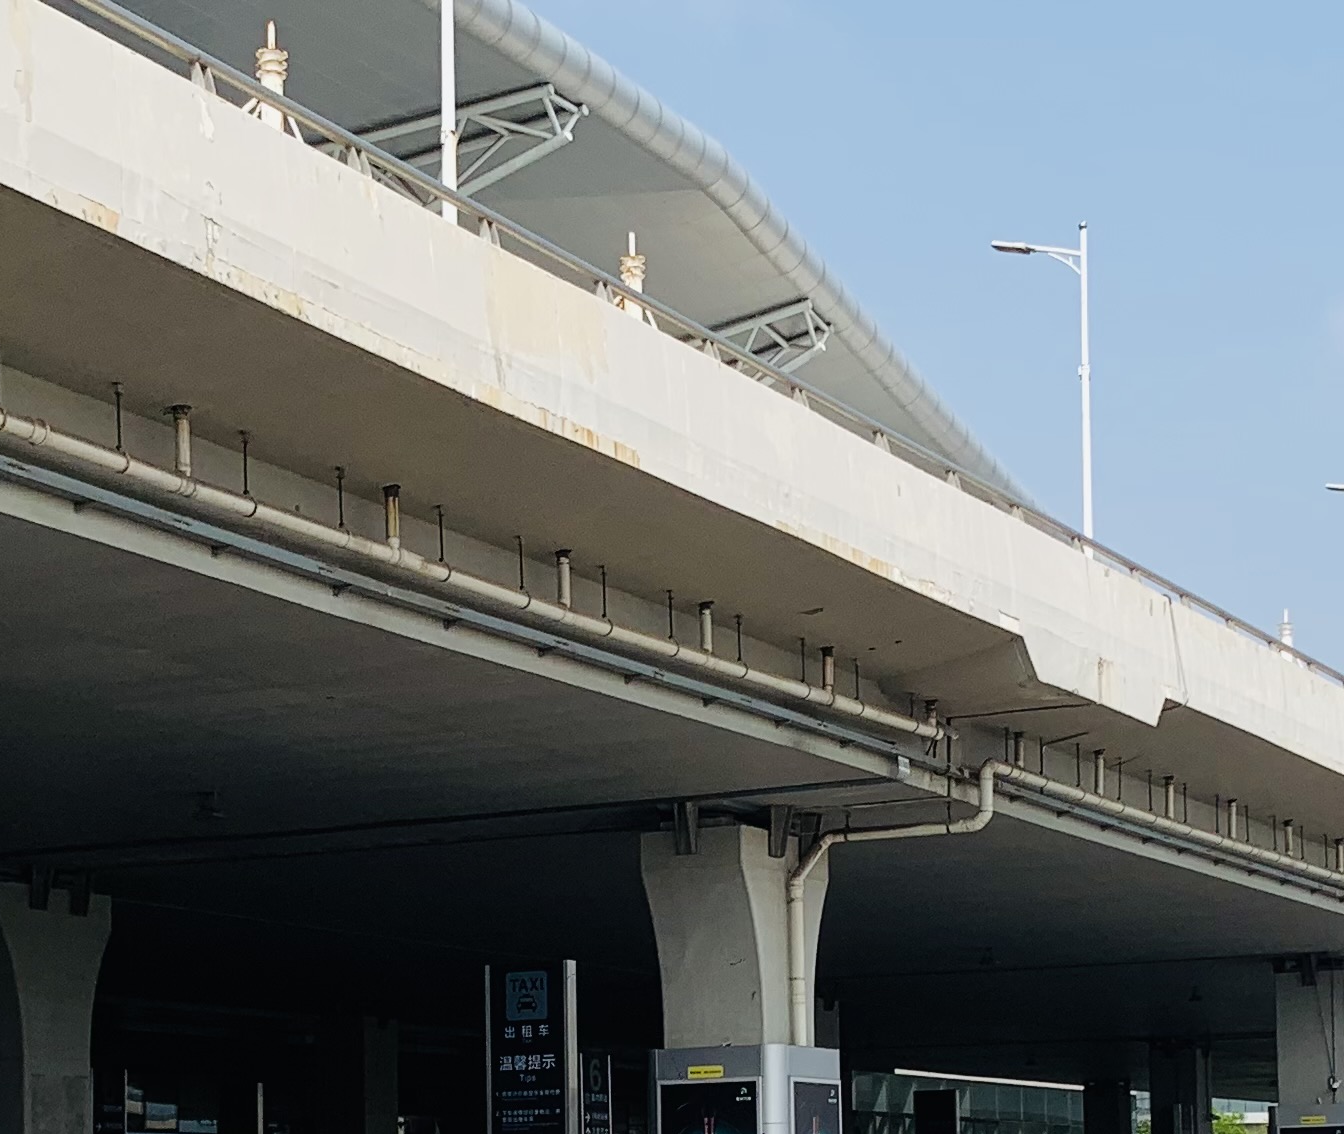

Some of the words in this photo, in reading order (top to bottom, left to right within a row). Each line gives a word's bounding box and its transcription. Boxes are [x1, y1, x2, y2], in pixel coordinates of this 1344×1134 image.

[509, 977, 545, 993] TAXI
[504, 1024, 550, 1039] 出租车
[499, 1054, 556, 1072] 温馨提示
[519, 1073, 537, 1083] Tips
[589, 1058, 602, 1092] 6
